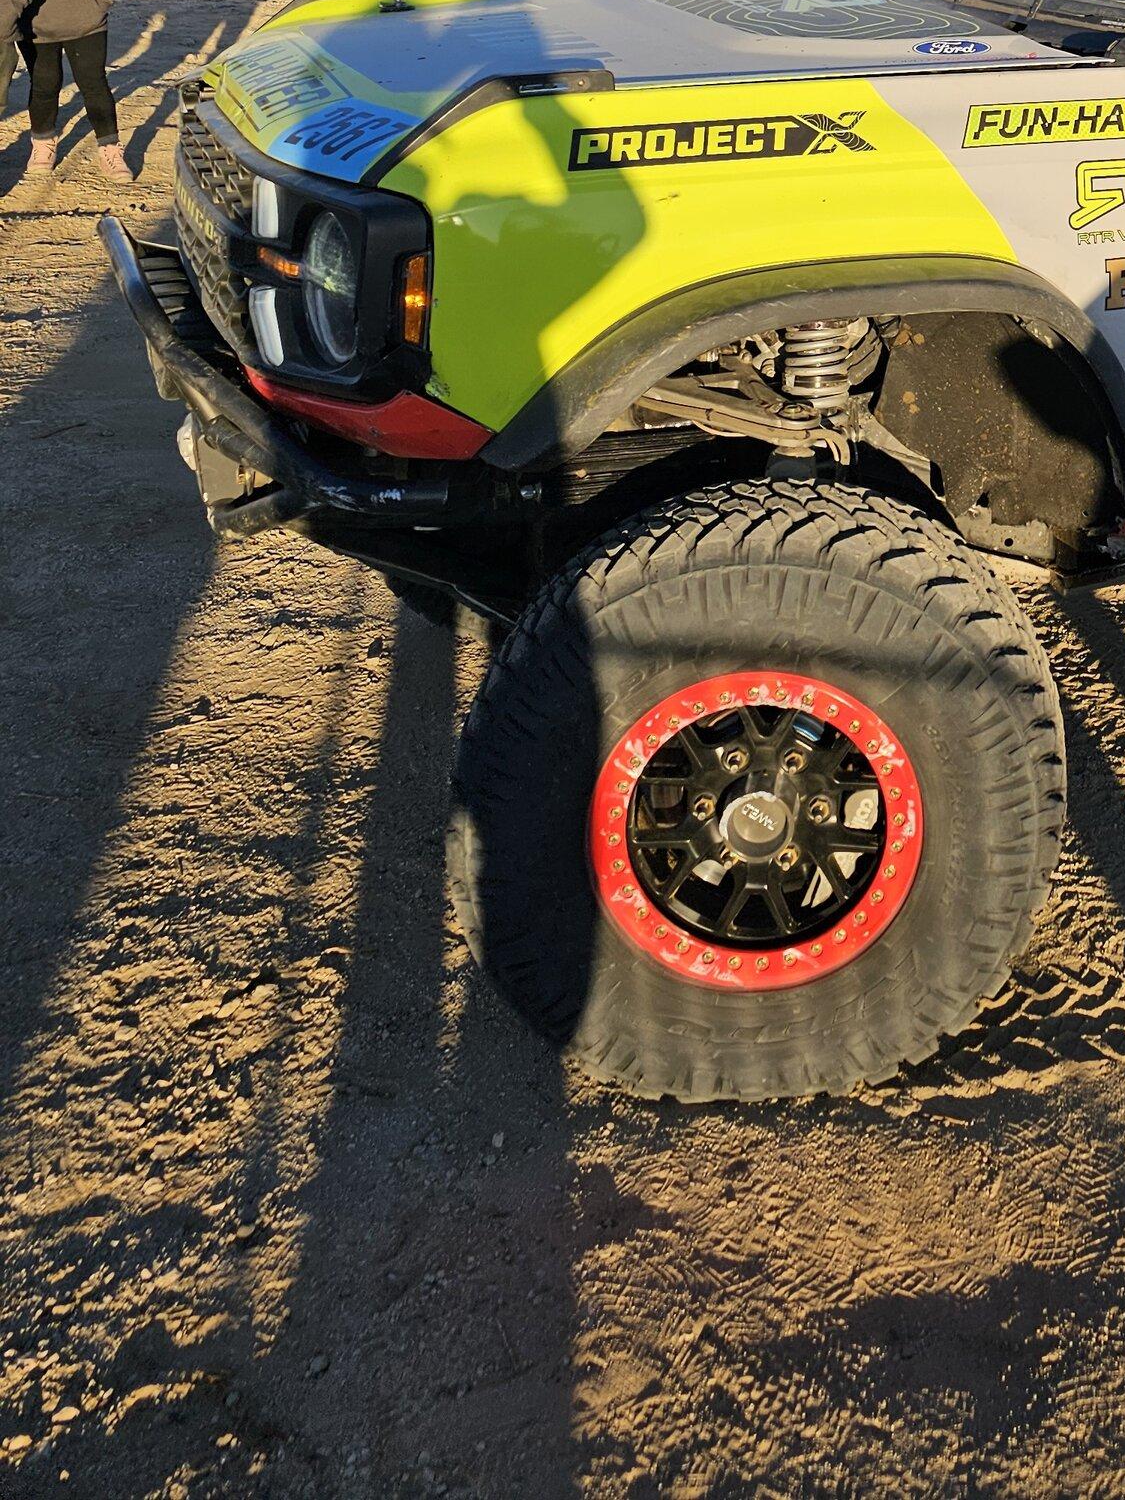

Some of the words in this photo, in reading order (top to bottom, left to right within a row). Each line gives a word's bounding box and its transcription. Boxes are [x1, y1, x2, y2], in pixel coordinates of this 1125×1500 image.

[283, 106, 415, 162] 2567
[576, 121, 800, 164] PROJECT
[1077, 230, 1115, 246] RTR
